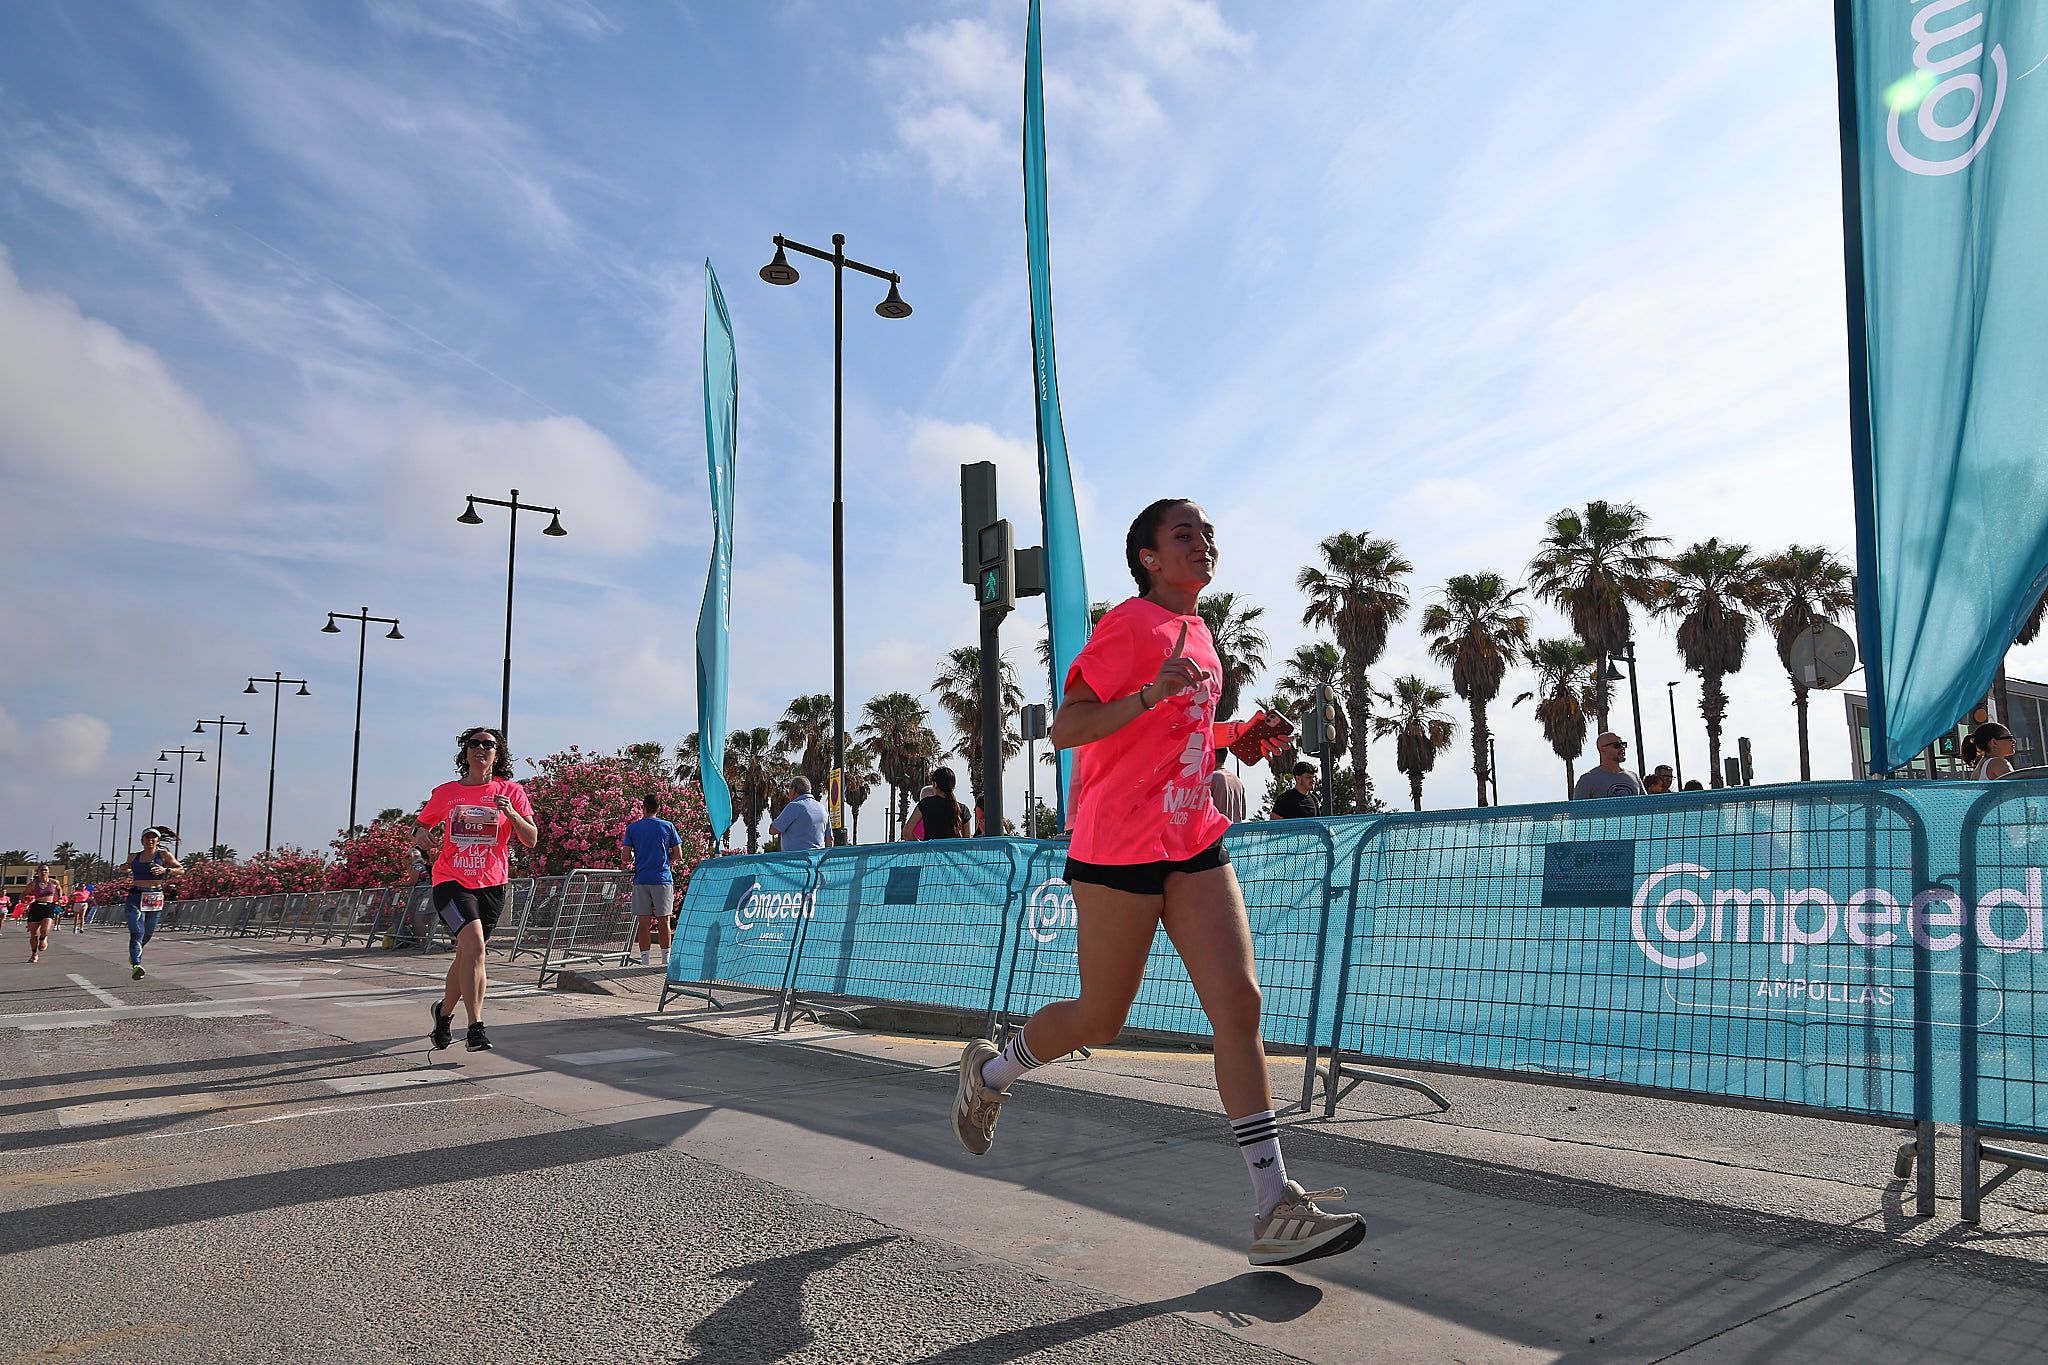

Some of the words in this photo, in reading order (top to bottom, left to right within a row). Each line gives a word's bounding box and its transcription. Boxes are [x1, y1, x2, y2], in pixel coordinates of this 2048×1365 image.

[453, 856, 486, 869] MUJER
[735, 882, 820, 930] Compeed
[1631, 862, 2043, 969] Compeed
[1756, 976, 1895, 1006] AMPOLLAS
